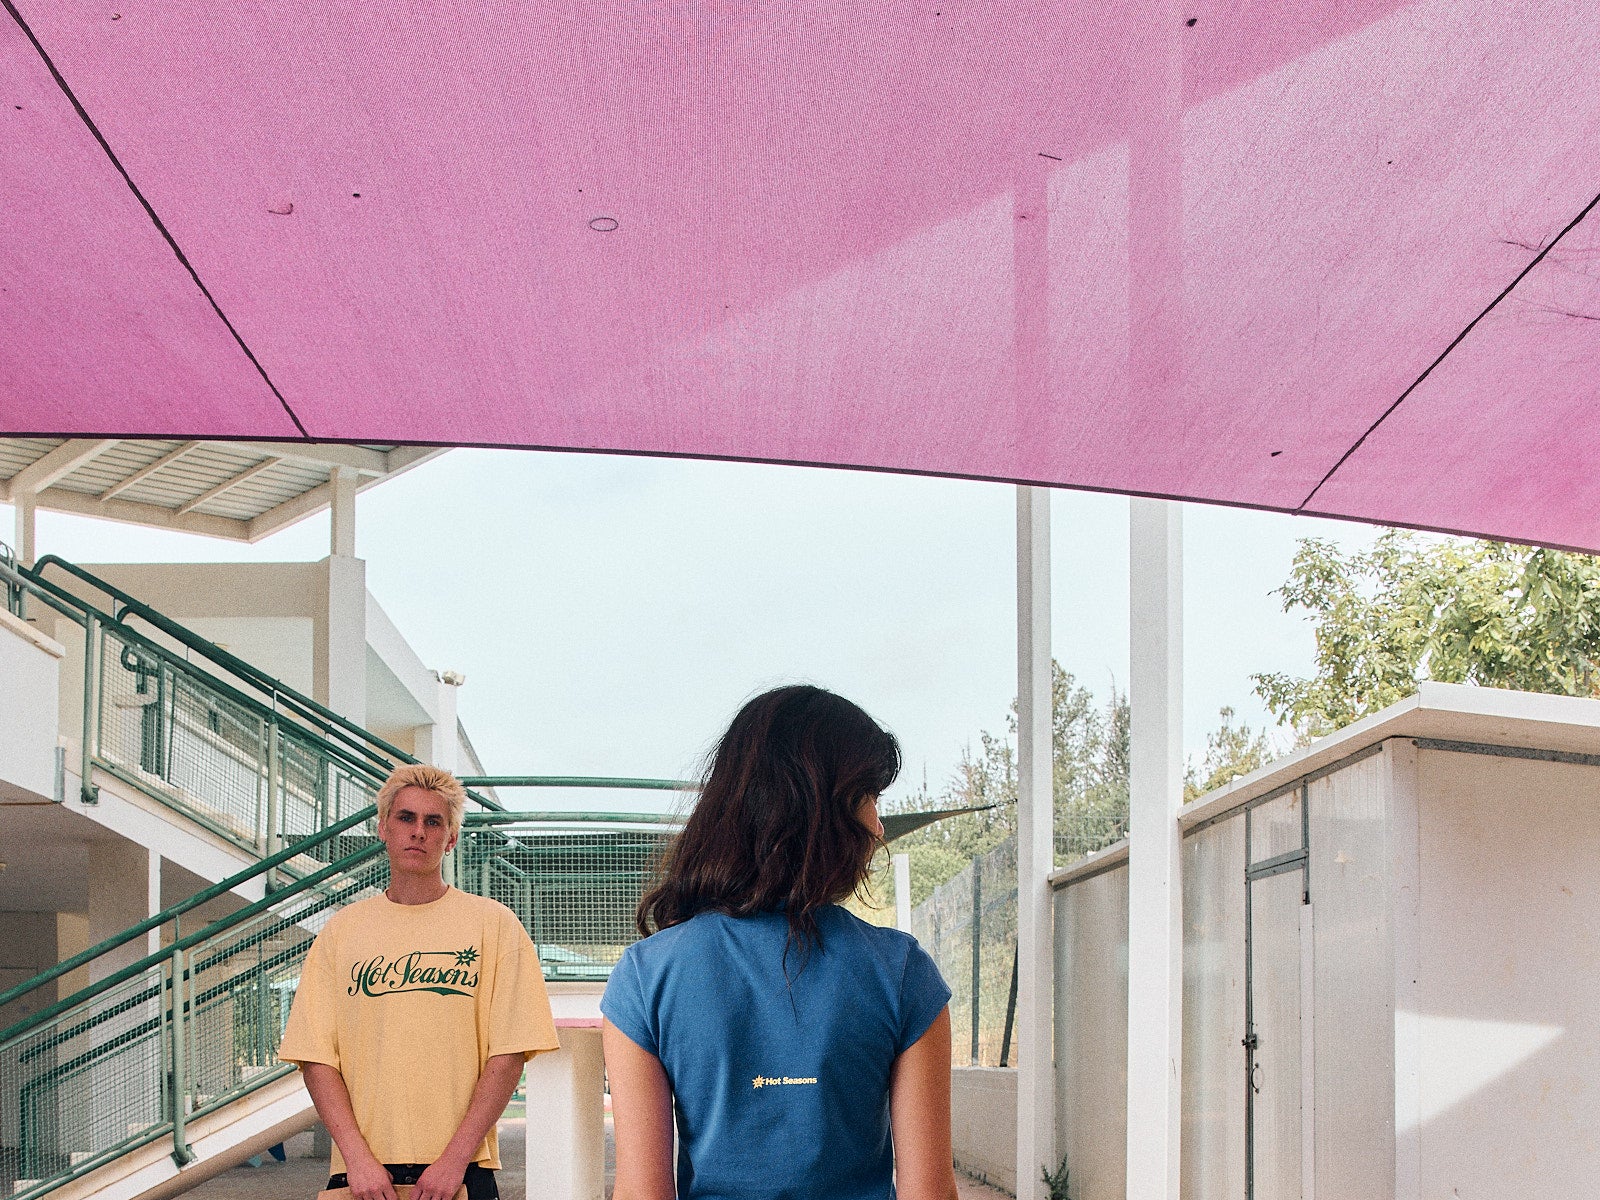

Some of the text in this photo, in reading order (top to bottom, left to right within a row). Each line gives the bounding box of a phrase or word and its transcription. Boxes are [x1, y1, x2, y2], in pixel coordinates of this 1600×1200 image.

[348, 951, 479, 997] Hot Seasons
[765, 1076, 818, 1085] Hot Seasons
